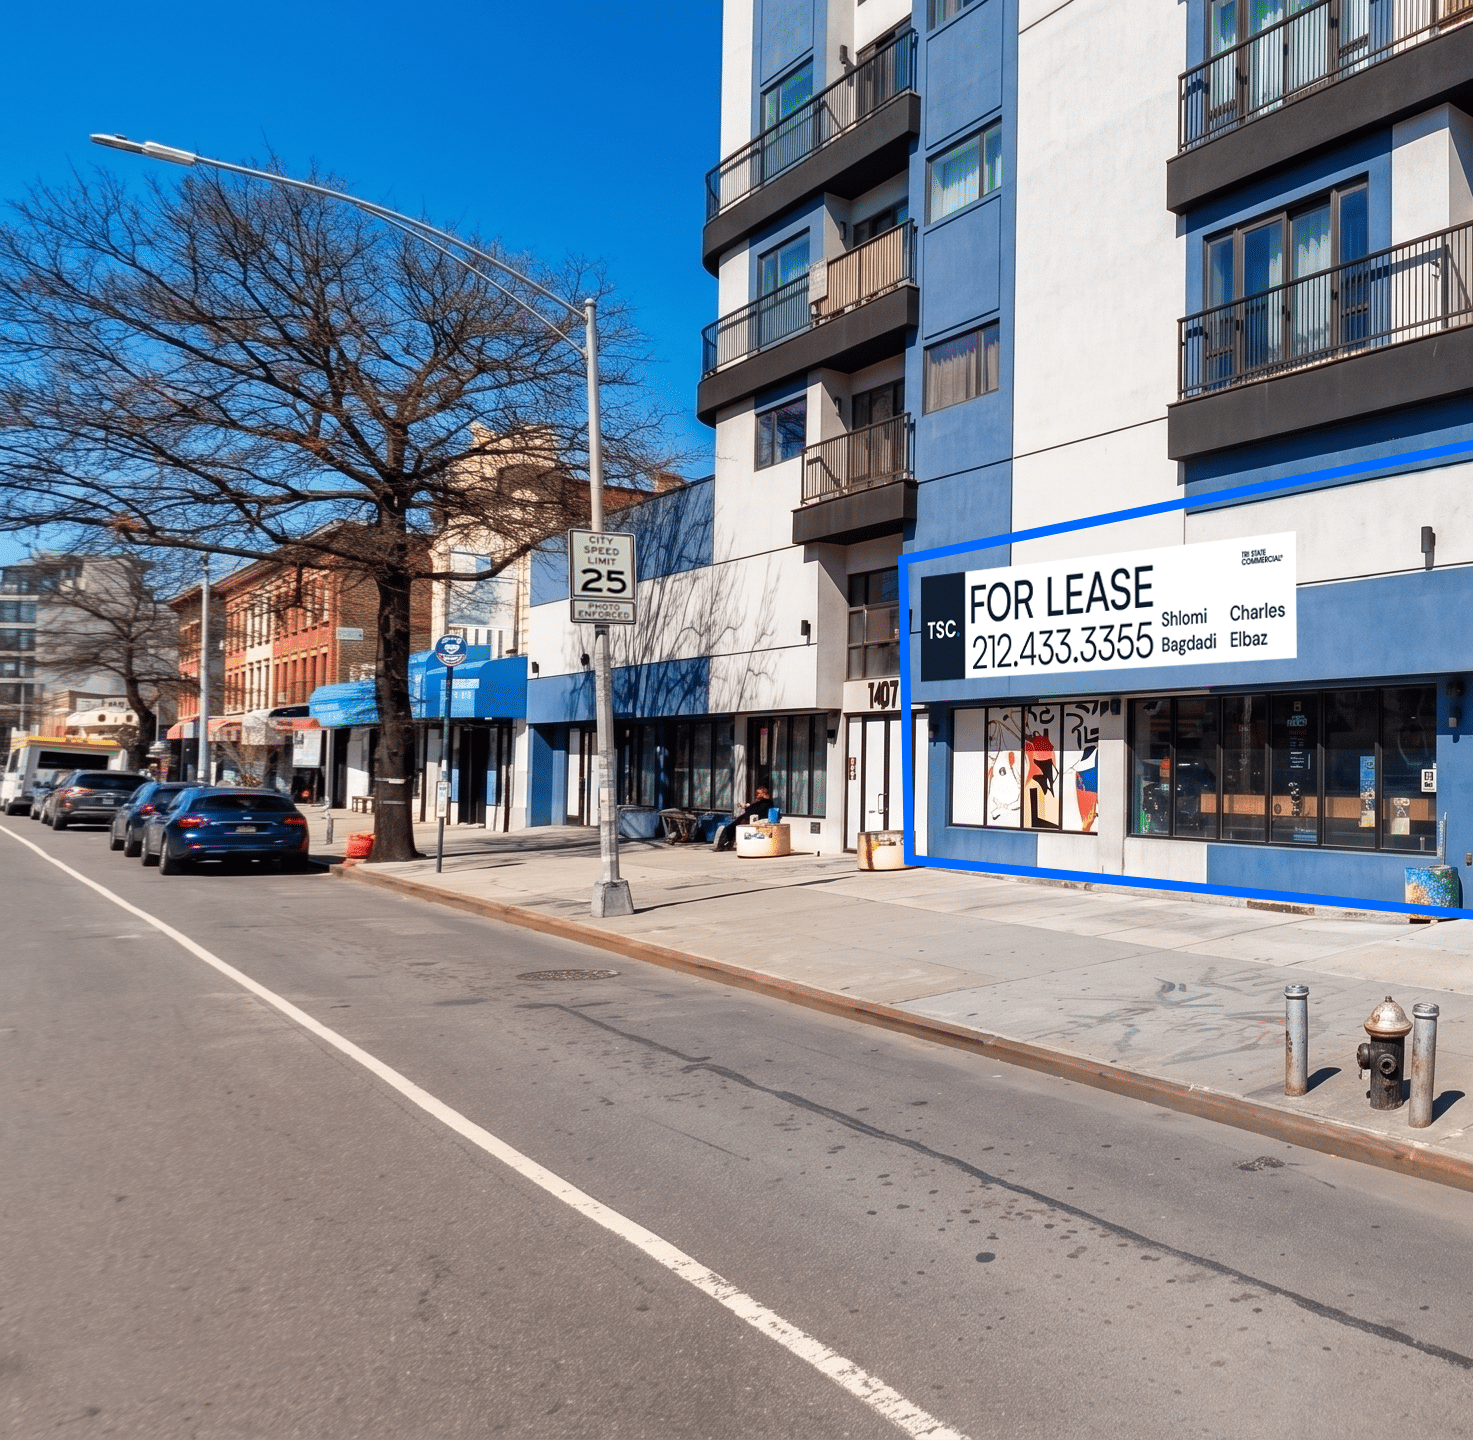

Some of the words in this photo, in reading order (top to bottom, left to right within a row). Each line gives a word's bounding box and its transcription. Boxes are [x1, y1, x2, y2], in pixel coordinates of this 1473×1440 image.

[589, 535, 614, 545] CITY
[584, 545, 620, 556] SPEED
[1251, 548, 1267, 557] STATE
[587, 556, 616, 566] LIMIT
[581, 568, 627, 594] 25
[971, 580, 1034, 624] FOR
[1047, 565, 1154, 617] LEASE
[578, 610, 630, 620] ENFORCED
[588, 602, 620, 611] PHOTO
[1230, 602, 1286, 622] Charles
[1161, 607, 1207, 628] Shlomi
[972, 621, 1154, 670] 212.433.3355
[1162, 632, 1217, 656] Bagdadi
[1230, 630, 1268, 648] Elbaz
[868, 680, 899, 709] 1407
